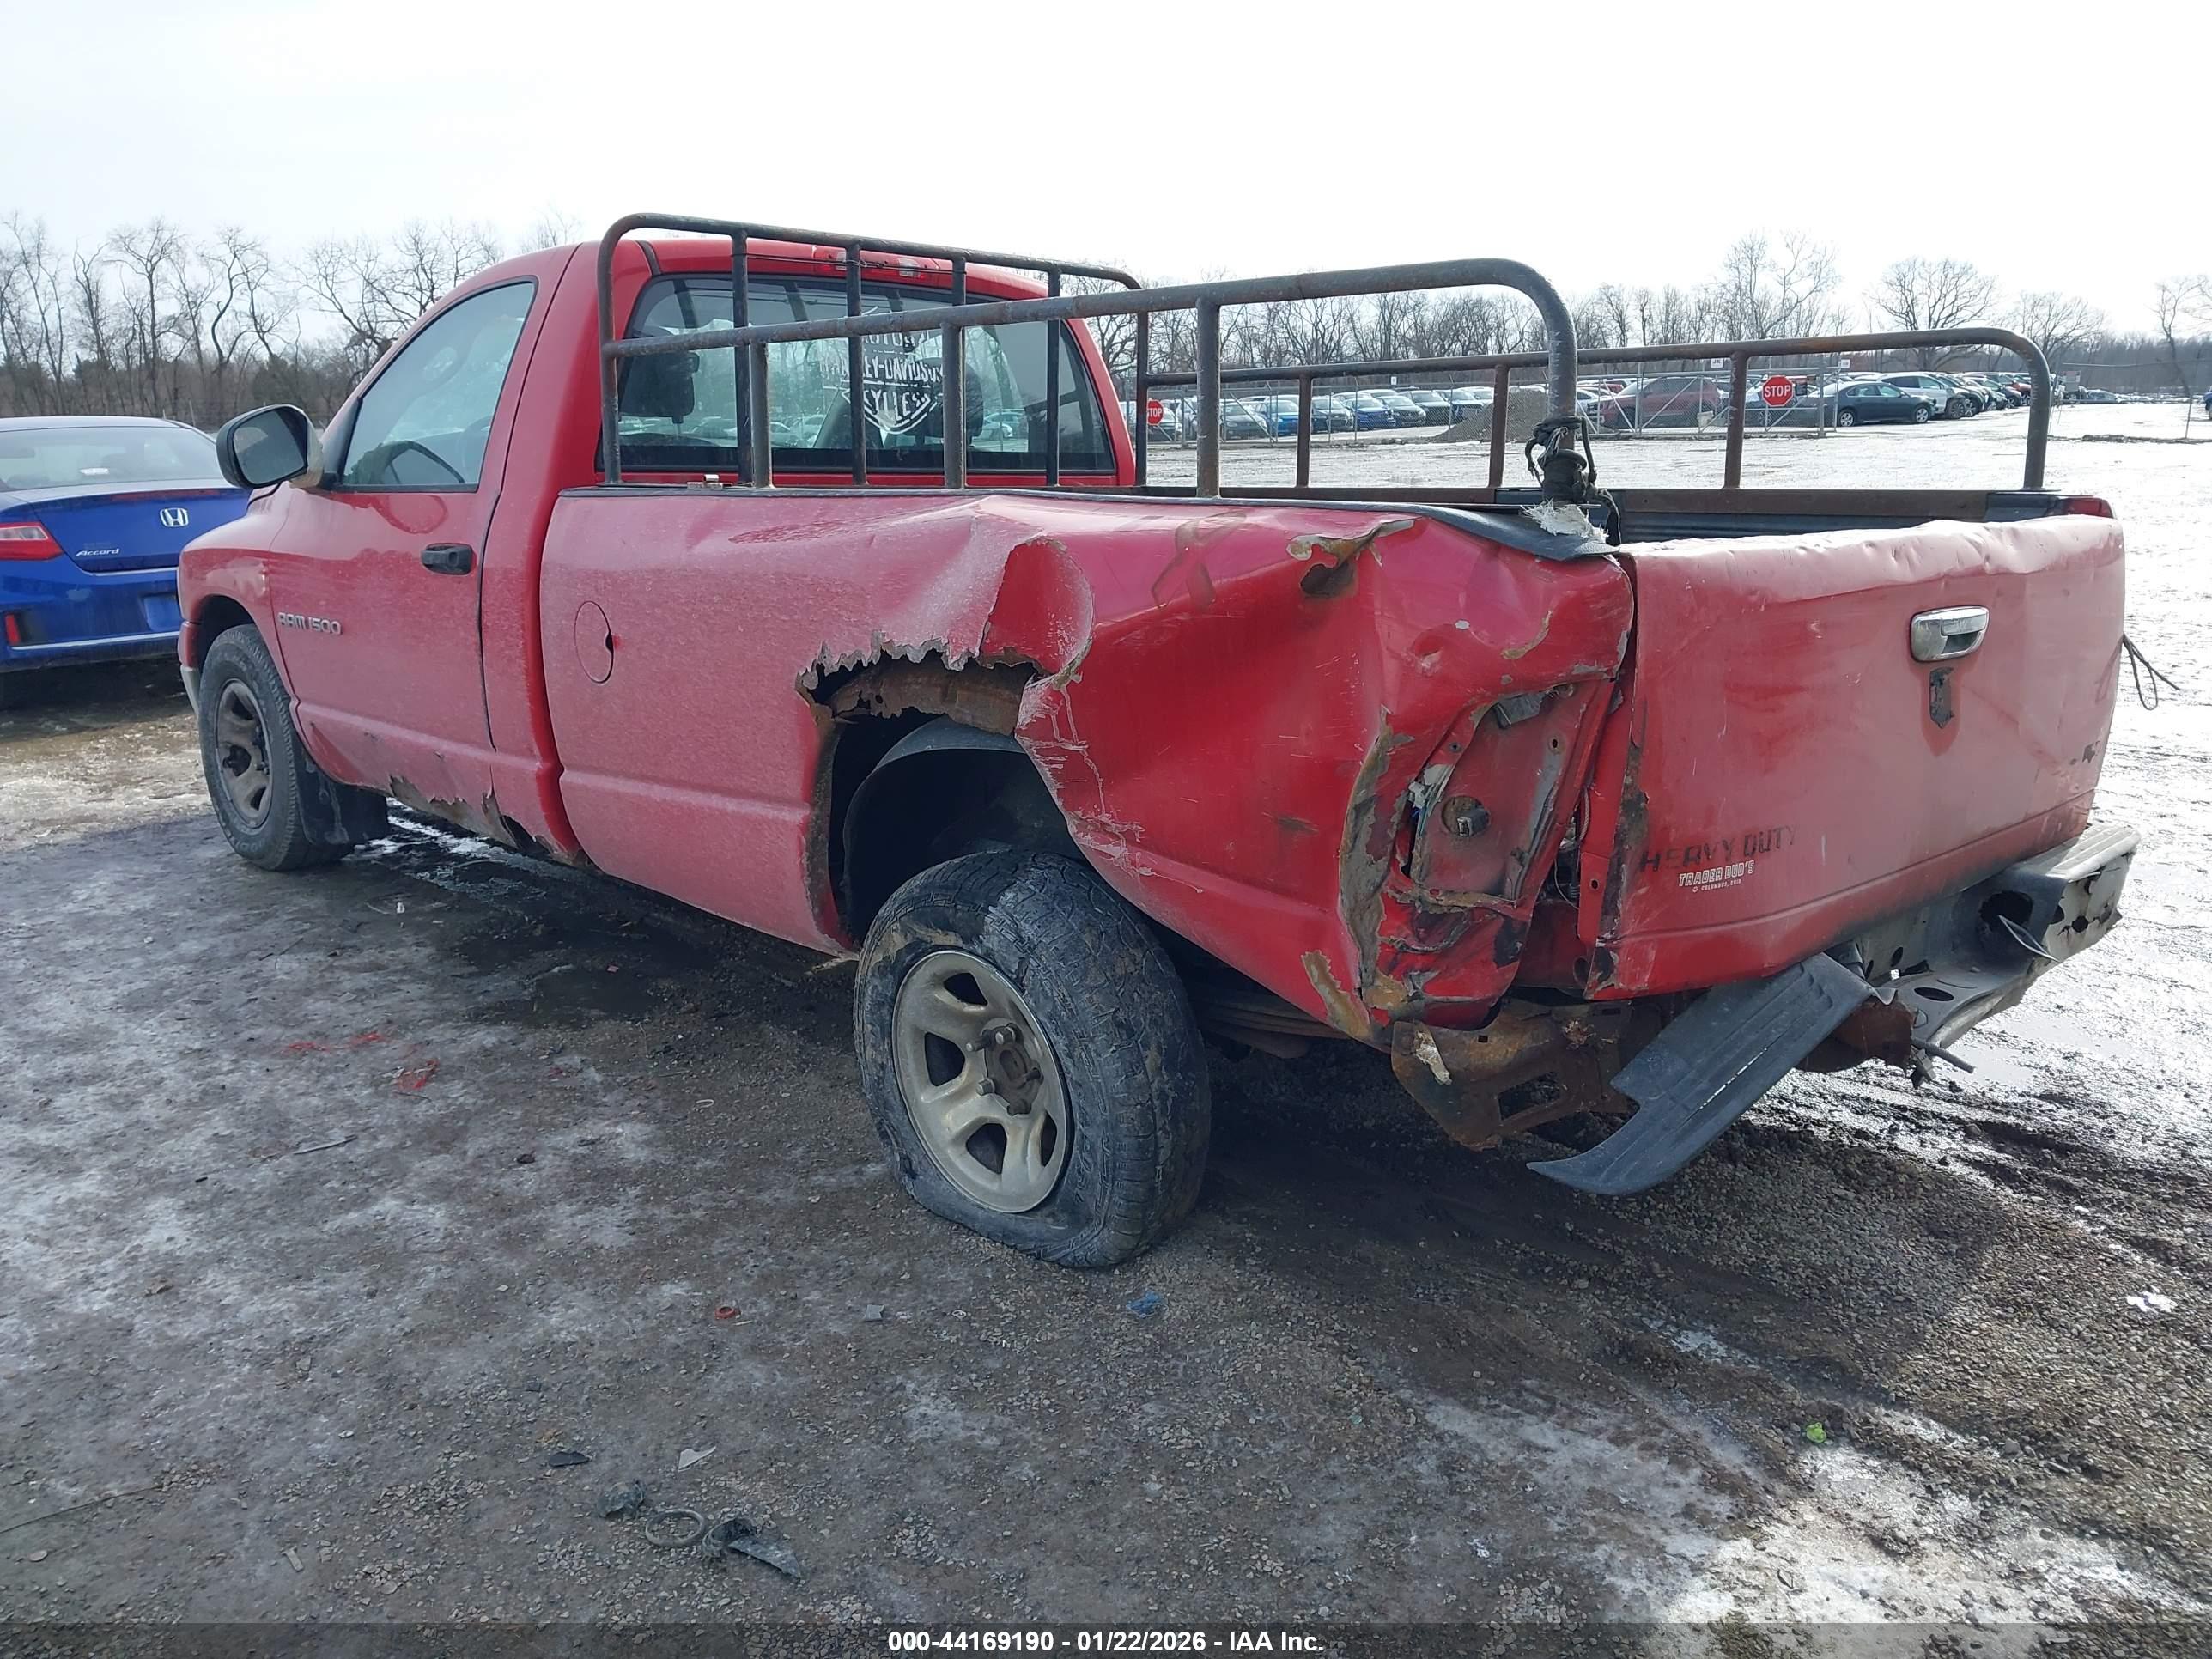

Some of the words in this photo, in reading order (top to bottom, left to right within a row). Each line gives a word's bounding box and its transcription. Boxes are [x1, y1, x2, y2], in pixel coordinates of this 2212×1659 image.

[1764, 385, 1791, 398] STOP
[1147, 407, 1163, 418] TOP
[75, 548, 120, 556] Accord
[307, 617, 342, 635] 1500
[1639, 838, 1735, 872] HEAVY
[1743, 825, 1798, 857] DUTY
[1678, 866, 1723, 887] TRADER
[1724, 860, 1755, 880] BUD'S
